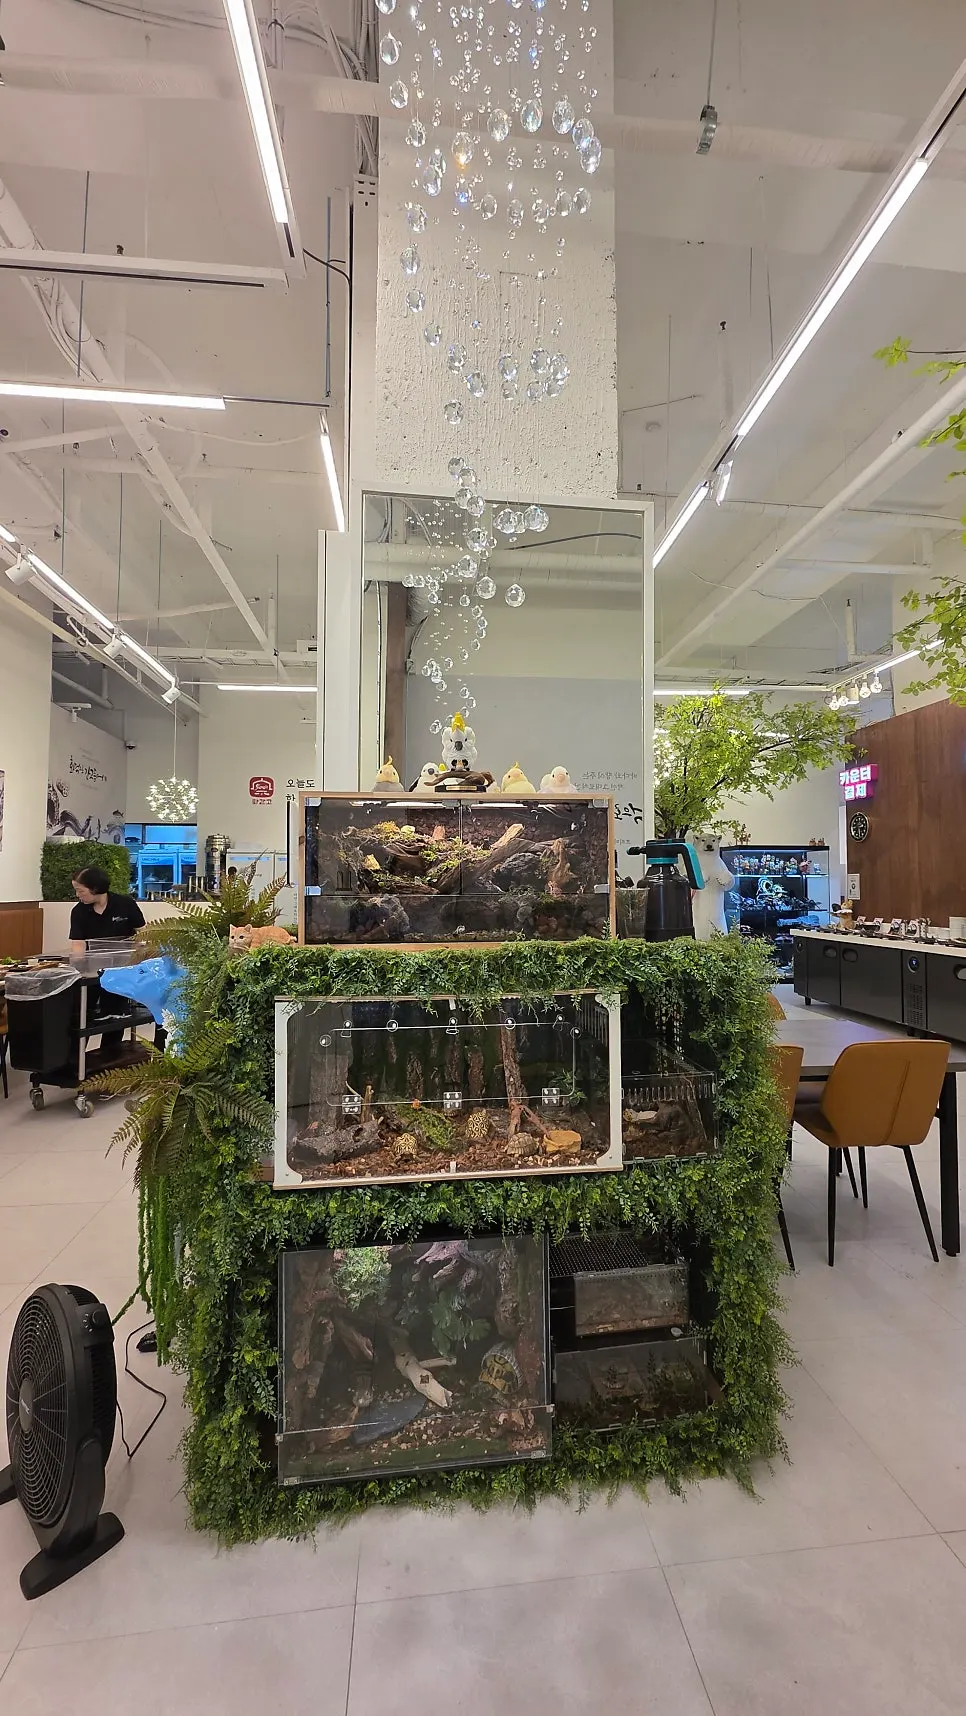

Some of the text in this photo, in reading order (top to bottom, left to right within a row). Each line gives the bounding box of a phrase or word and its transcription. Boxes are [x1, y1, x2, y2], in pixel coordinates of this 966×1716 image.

[285, 778, 316, 789] 오늘도
[839, 765, 872, 785] 카운터
[844, 783, 867, 801] 결제
